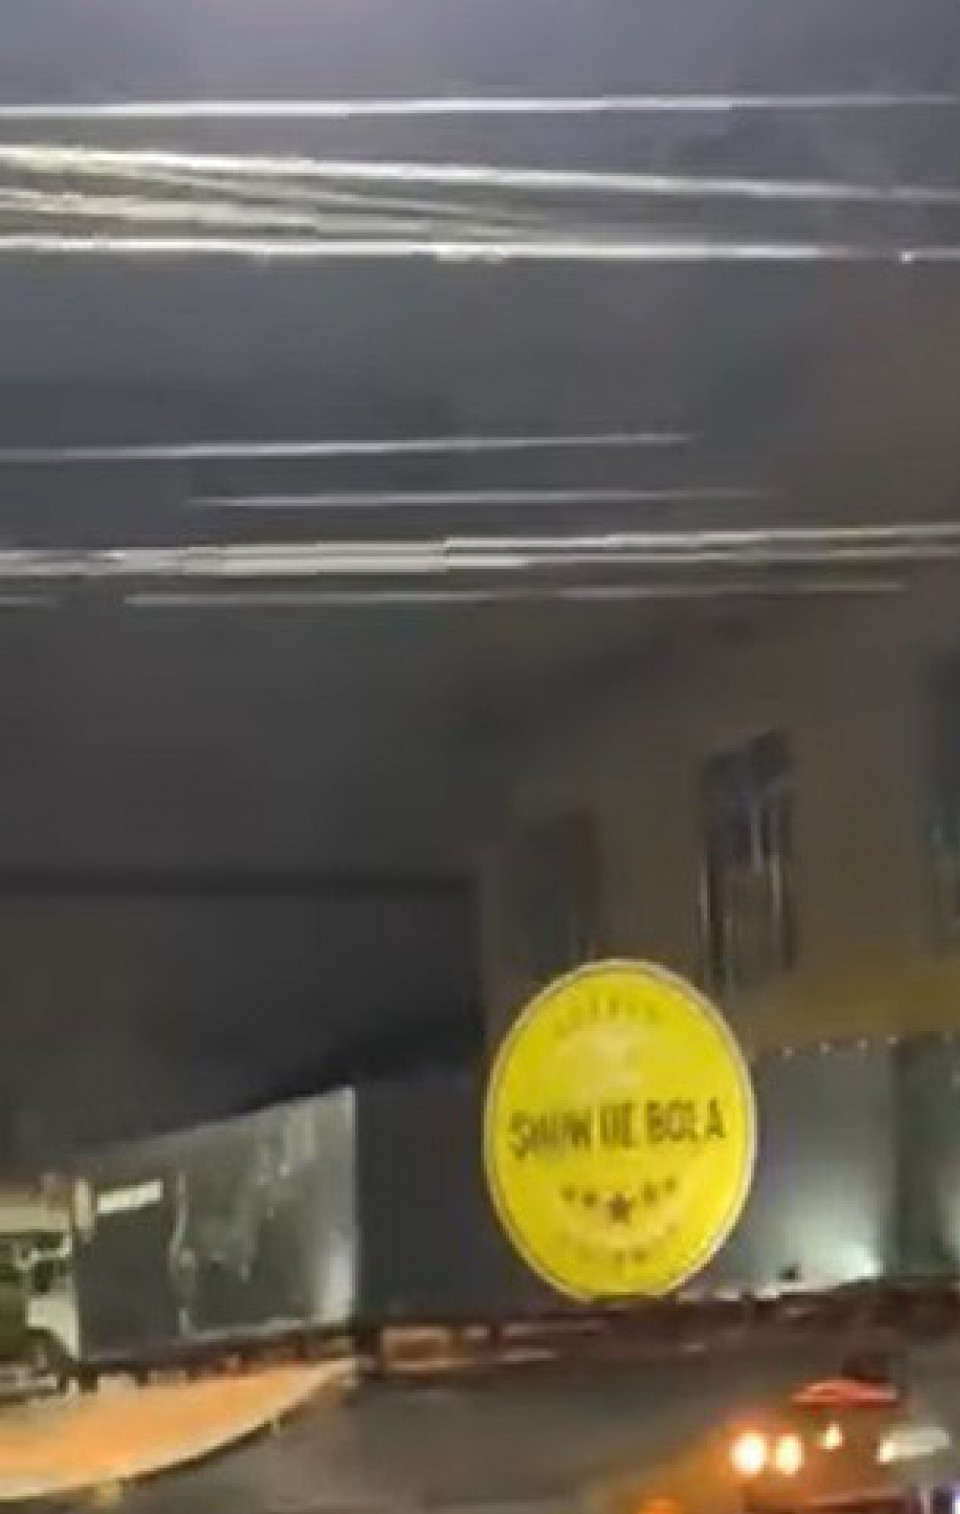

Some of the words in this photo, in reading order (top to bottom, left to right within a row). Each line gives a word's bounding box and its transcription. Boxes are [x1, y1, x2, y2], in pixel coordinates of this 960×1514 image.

[509, 1104, 592, 1160] SHOW
[599, 1102, 635, 1150] DE
[644, 1097, 727, 1145] BOLA
